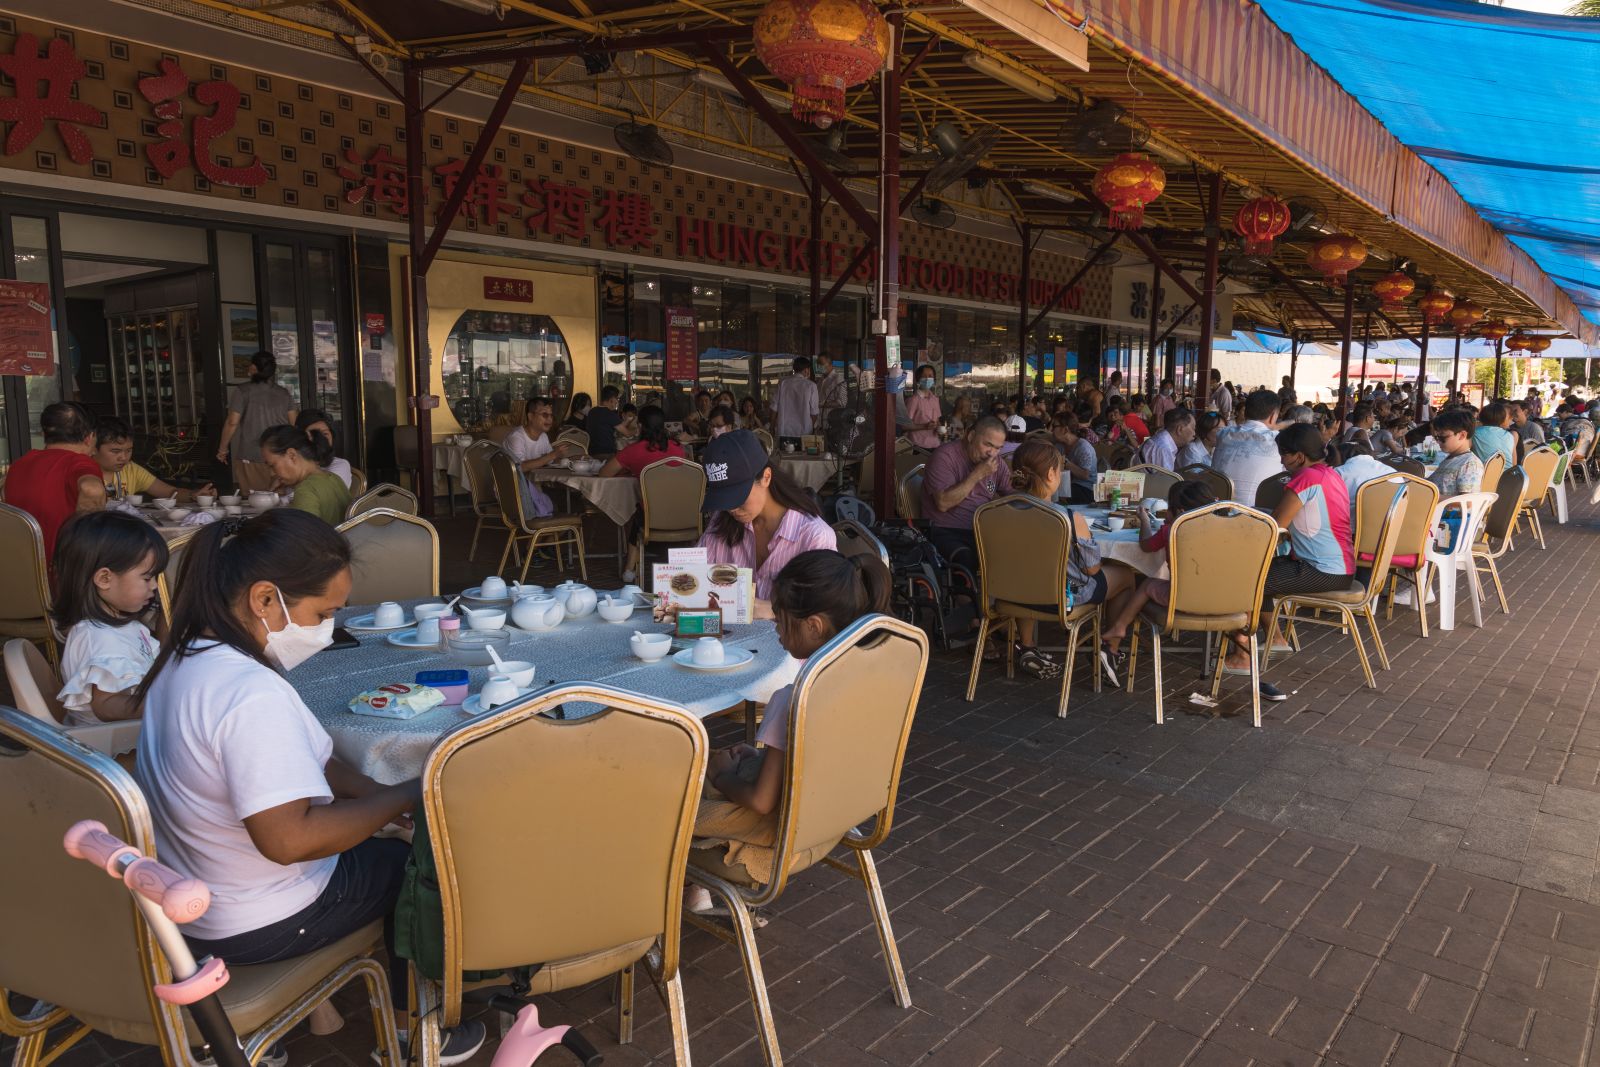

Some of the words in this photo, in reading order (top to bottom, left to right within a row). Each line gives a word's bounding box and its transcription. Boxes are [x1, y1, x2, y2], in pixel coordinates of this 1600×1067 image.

[677, 216, 781, 268] HUNG
[852, 246, 963, 294] SFOOD
[971, 267, 1085, 311] RESTURANT
